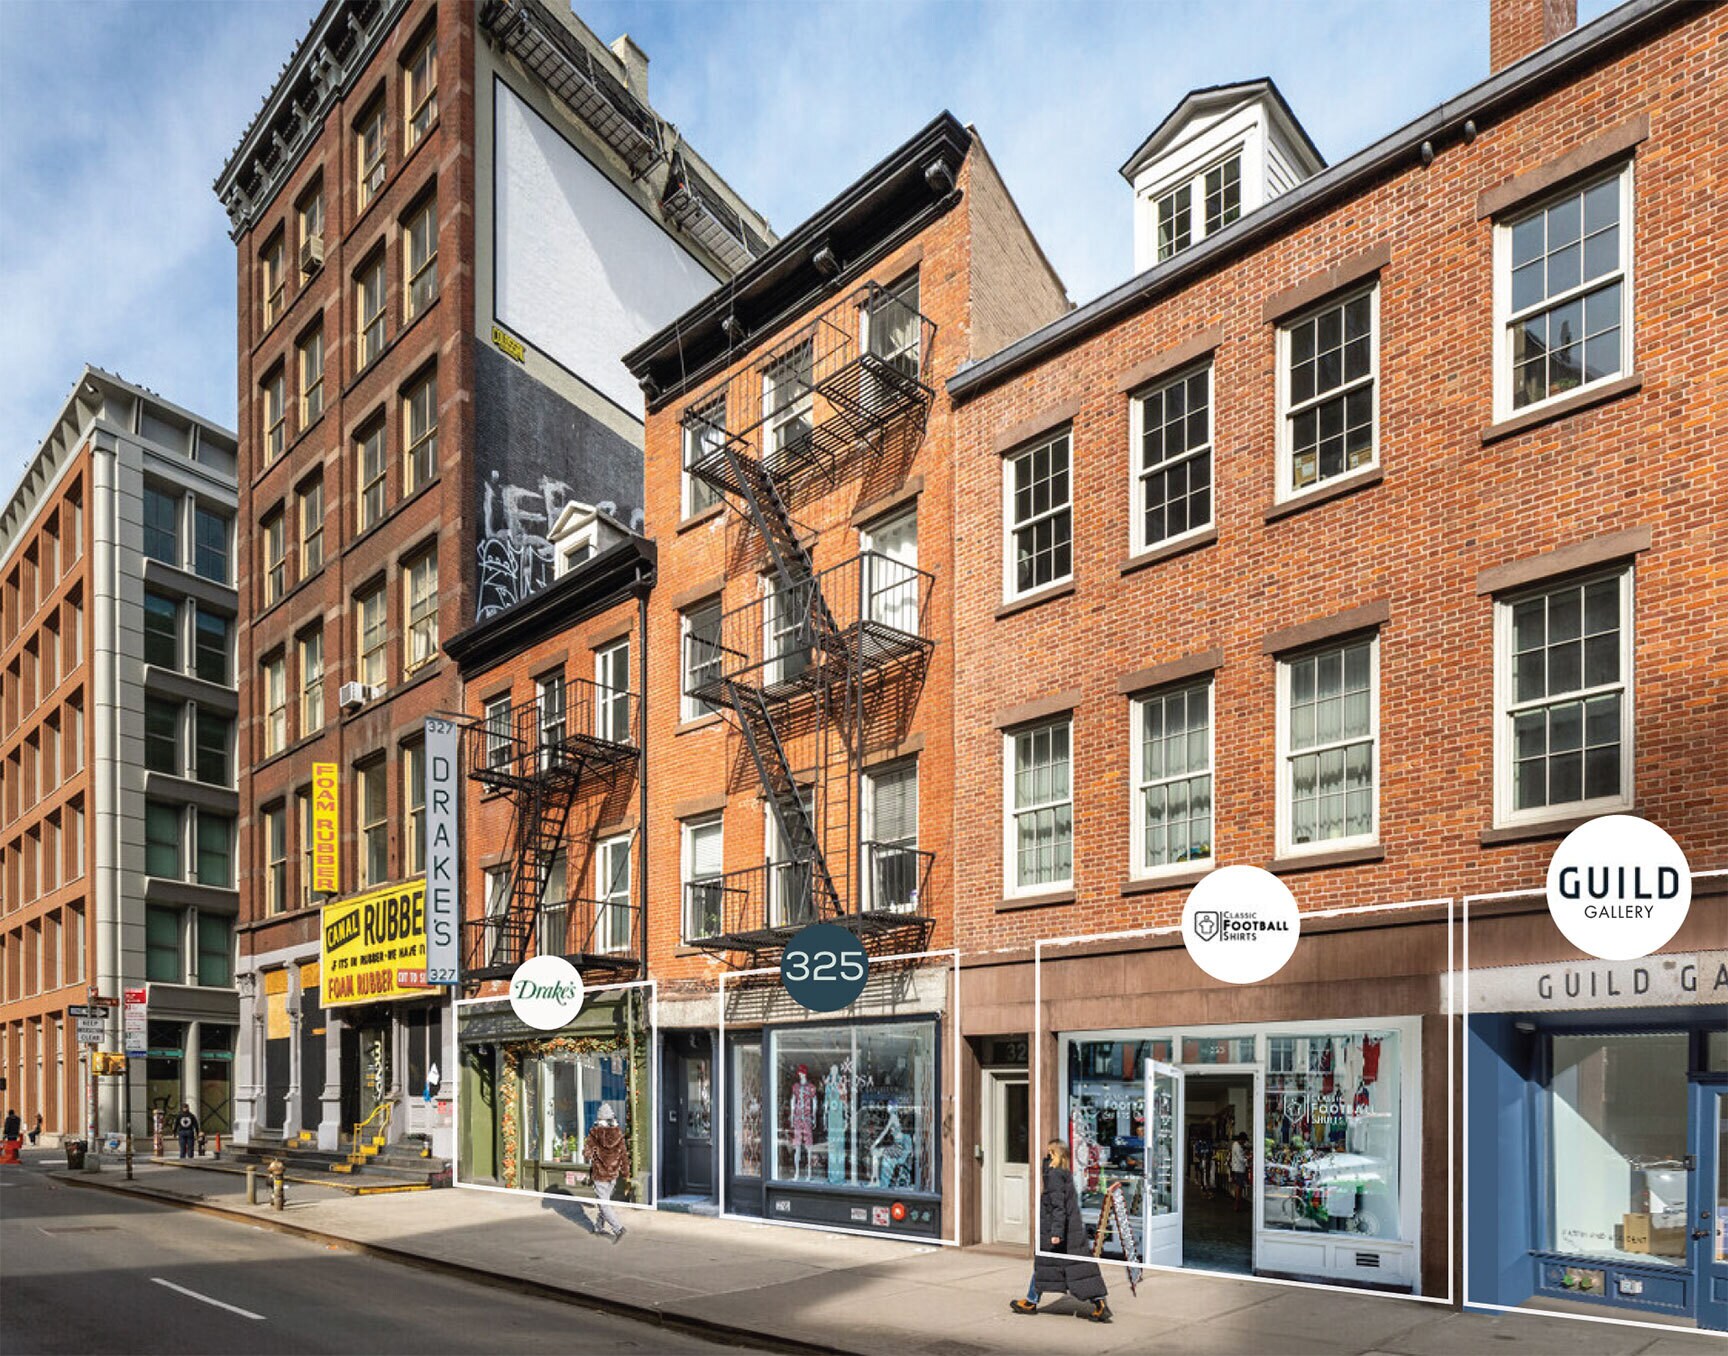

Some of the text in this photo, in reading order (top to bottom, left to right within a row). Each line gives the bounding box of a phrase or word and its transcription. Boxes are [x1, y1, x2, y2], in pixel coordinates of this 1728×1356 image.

[428, 721, 453, 734] 327
[316, 765, 335, 889] FOAM RUBBER
[327, 910, 359, 950] CANAL
[328, 968, 394, 999] FOAM RUBBER
[430, 969, 456, 981] 327
[1538, 968, 1649, 999] GUILD
